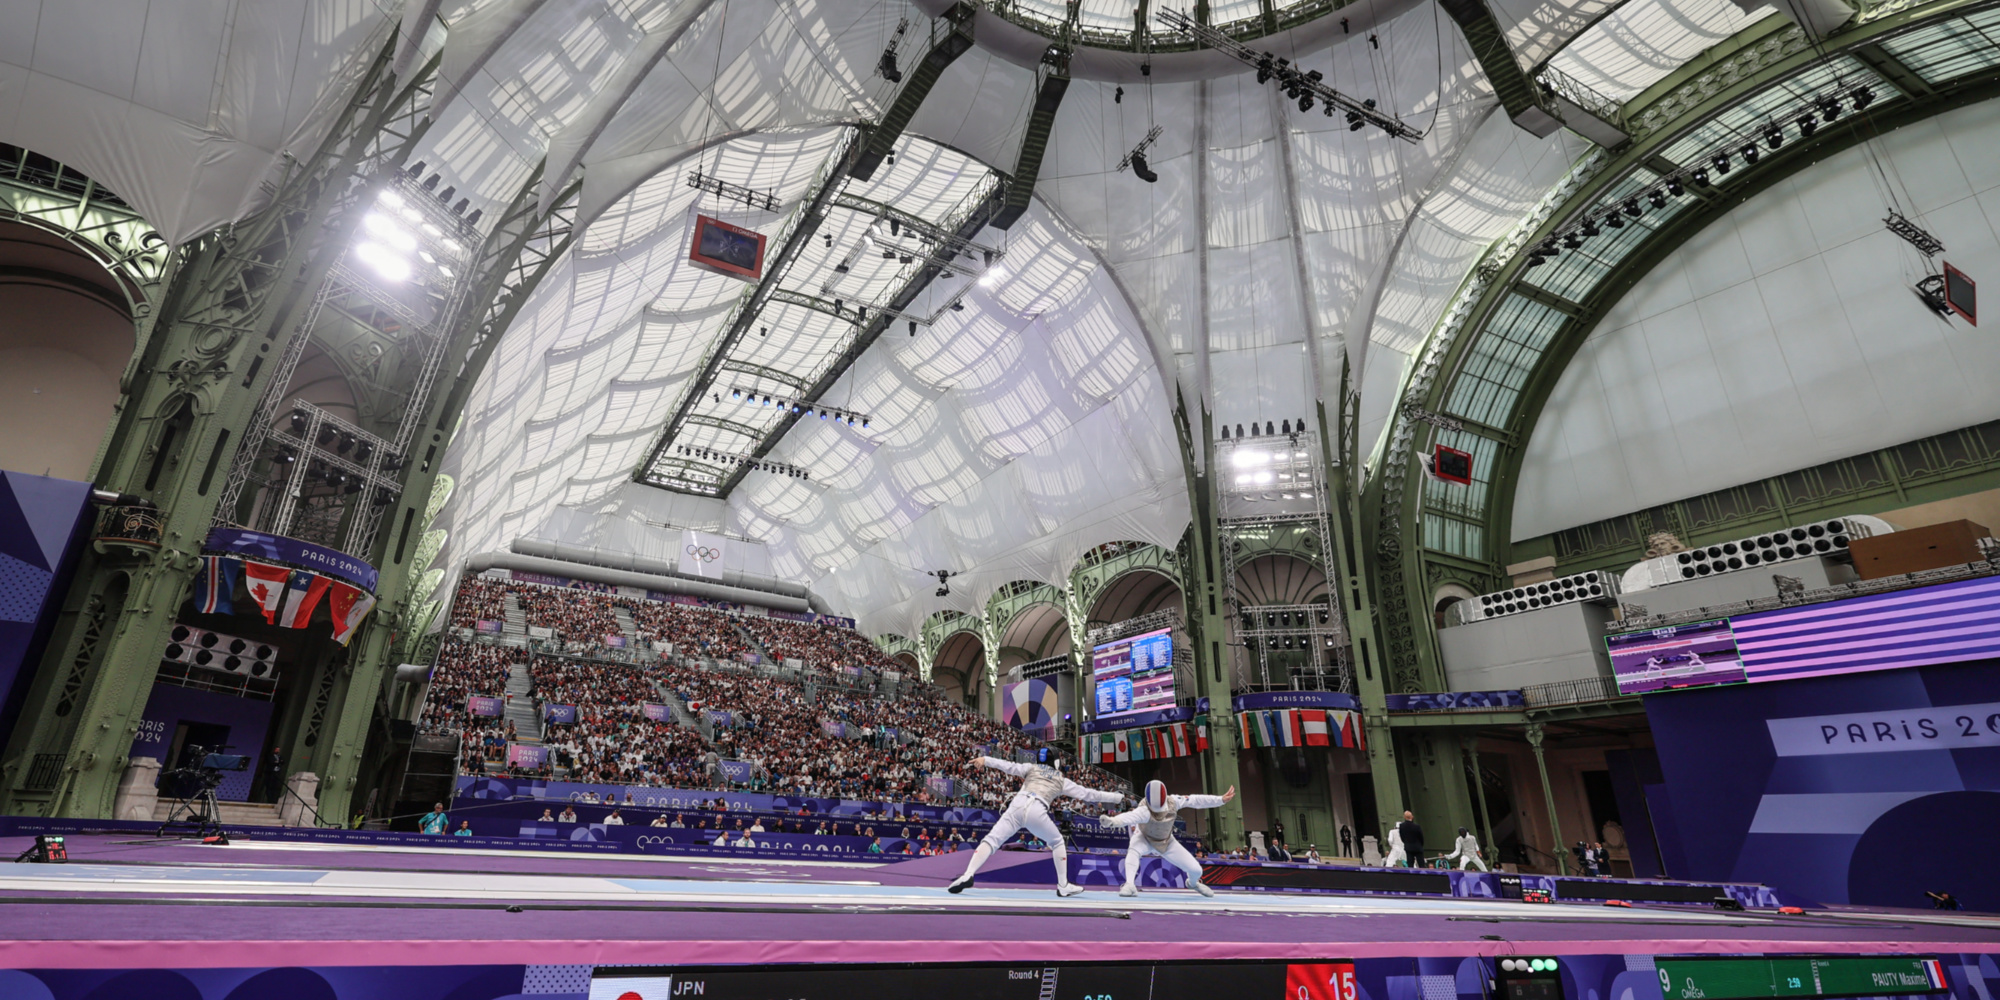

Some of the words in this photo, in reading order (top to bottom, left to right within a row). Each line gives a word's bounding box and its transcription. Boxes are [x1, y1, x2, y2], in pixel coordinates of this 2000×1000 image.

[339, 561, 362, 576] 2024
[1008, 970, 1033, 980] Round
[1034, 970, 1039, 979] 4
[1659, 968, 1671, 993] 9
[1871, 972, 1899, 987] PAUTY
[1900, 972, 1927, 986] Maxime
[673, 981, 705, 996] JPN
[1329, 972, 1356, 1000] 15
[1681, 988, 1705, 999] OMEGA
